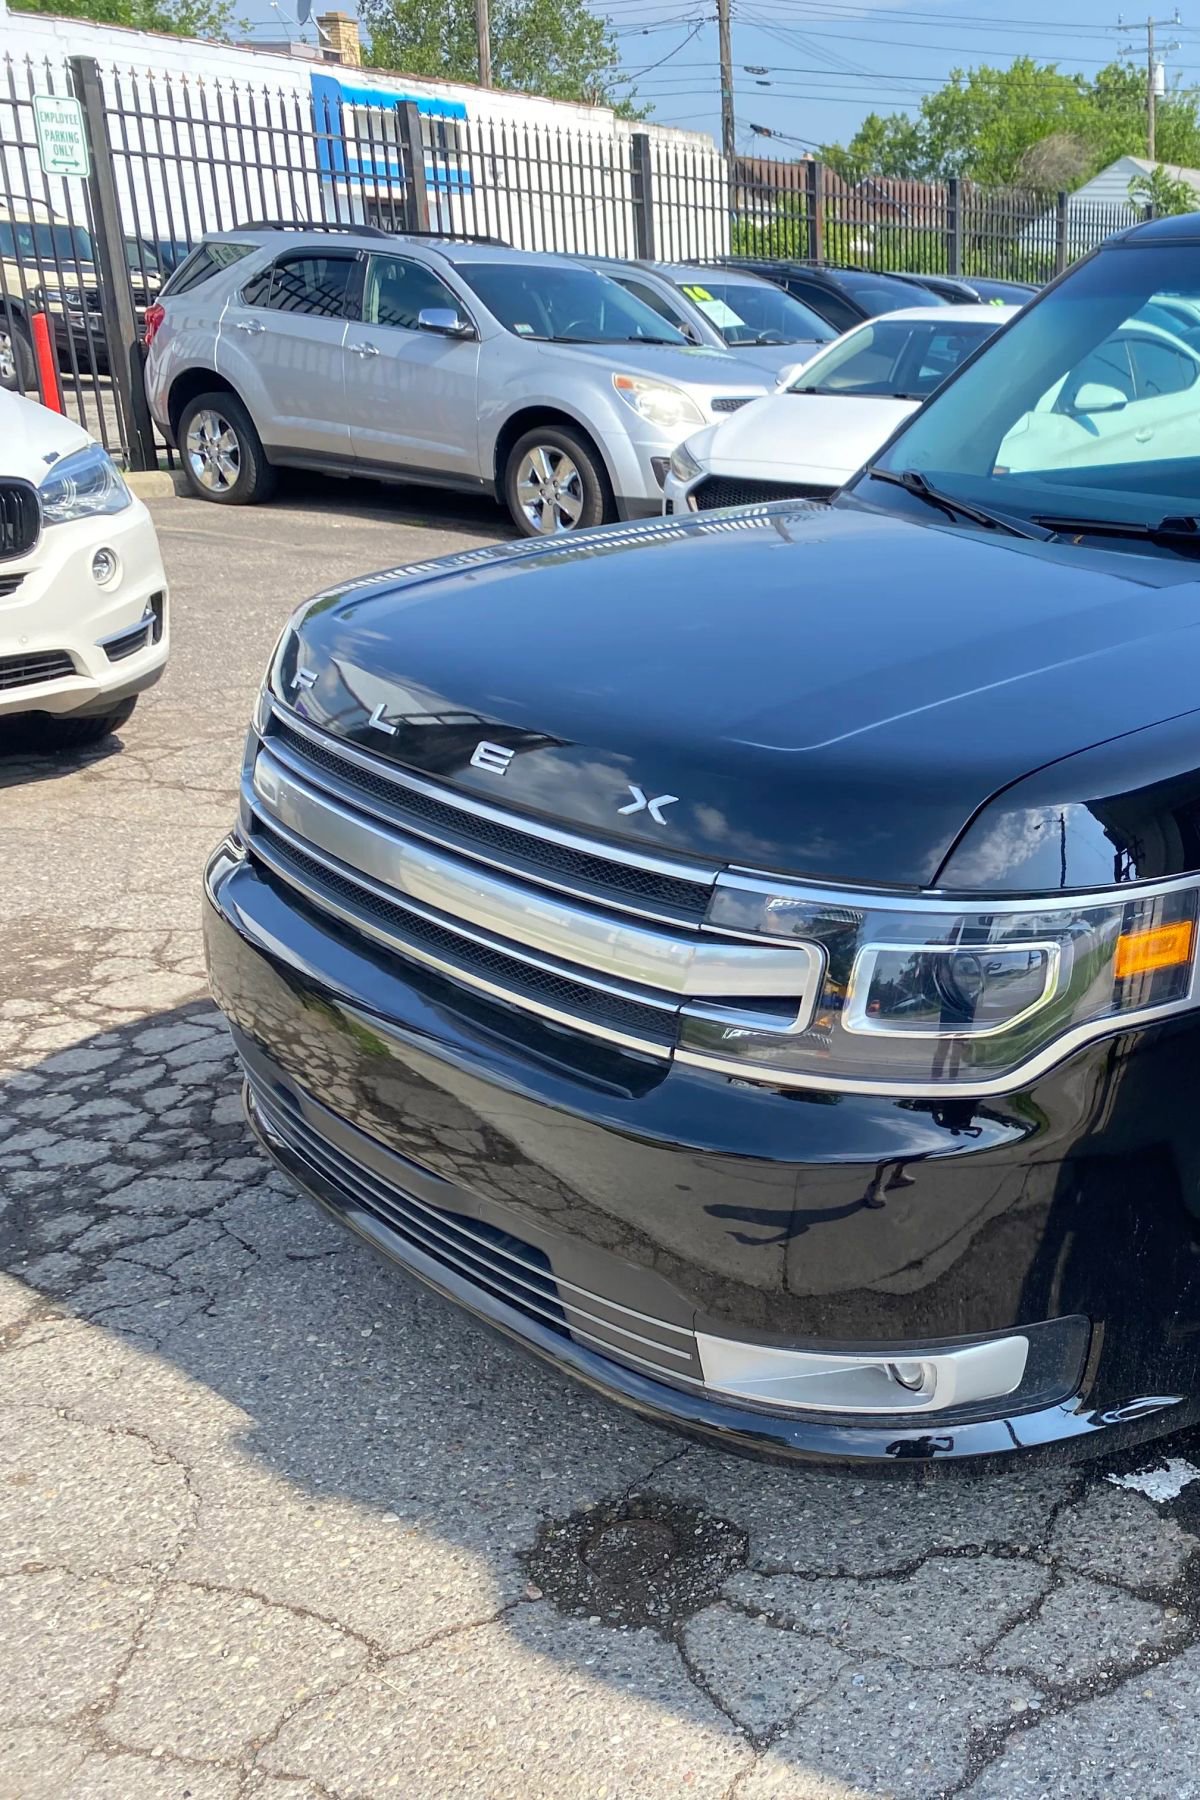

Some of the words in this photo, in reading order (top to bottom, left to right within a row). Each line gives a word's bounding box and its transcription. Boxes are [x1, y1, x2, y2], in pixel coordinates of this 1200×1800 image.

[40, 111, 79, 126] EMPLOYEE
[44, 129, 80, 144] PARKING
[53, 143, 74, 157] ONLY
[290, 667, 680, 826] FLEX
